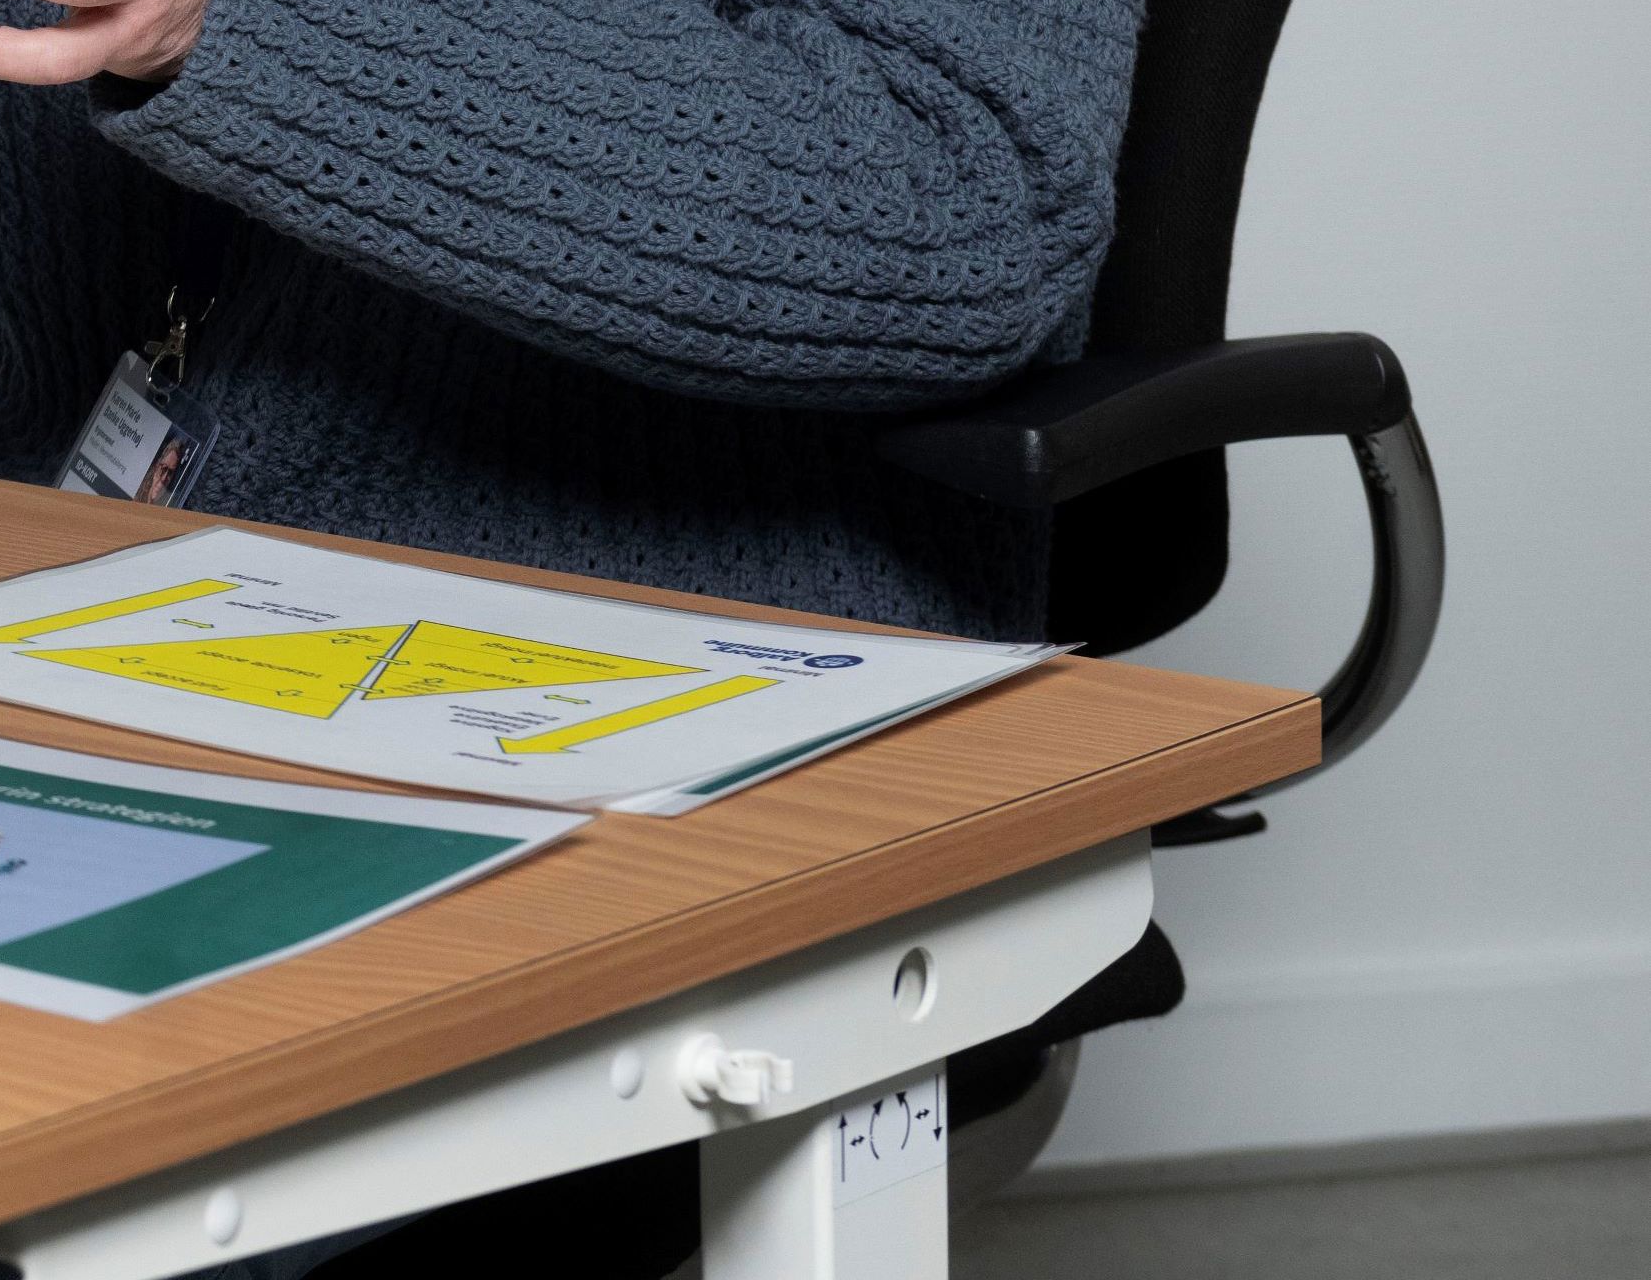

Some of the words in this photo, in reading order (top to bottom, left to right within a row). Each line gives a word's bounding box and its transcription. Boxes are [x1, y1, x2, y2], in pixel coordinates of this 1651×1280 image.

[704, 640, 812, 657] Kommune
[711, 646, 798, 661] Aalborg
[44, 792, 217, 830] strategien
